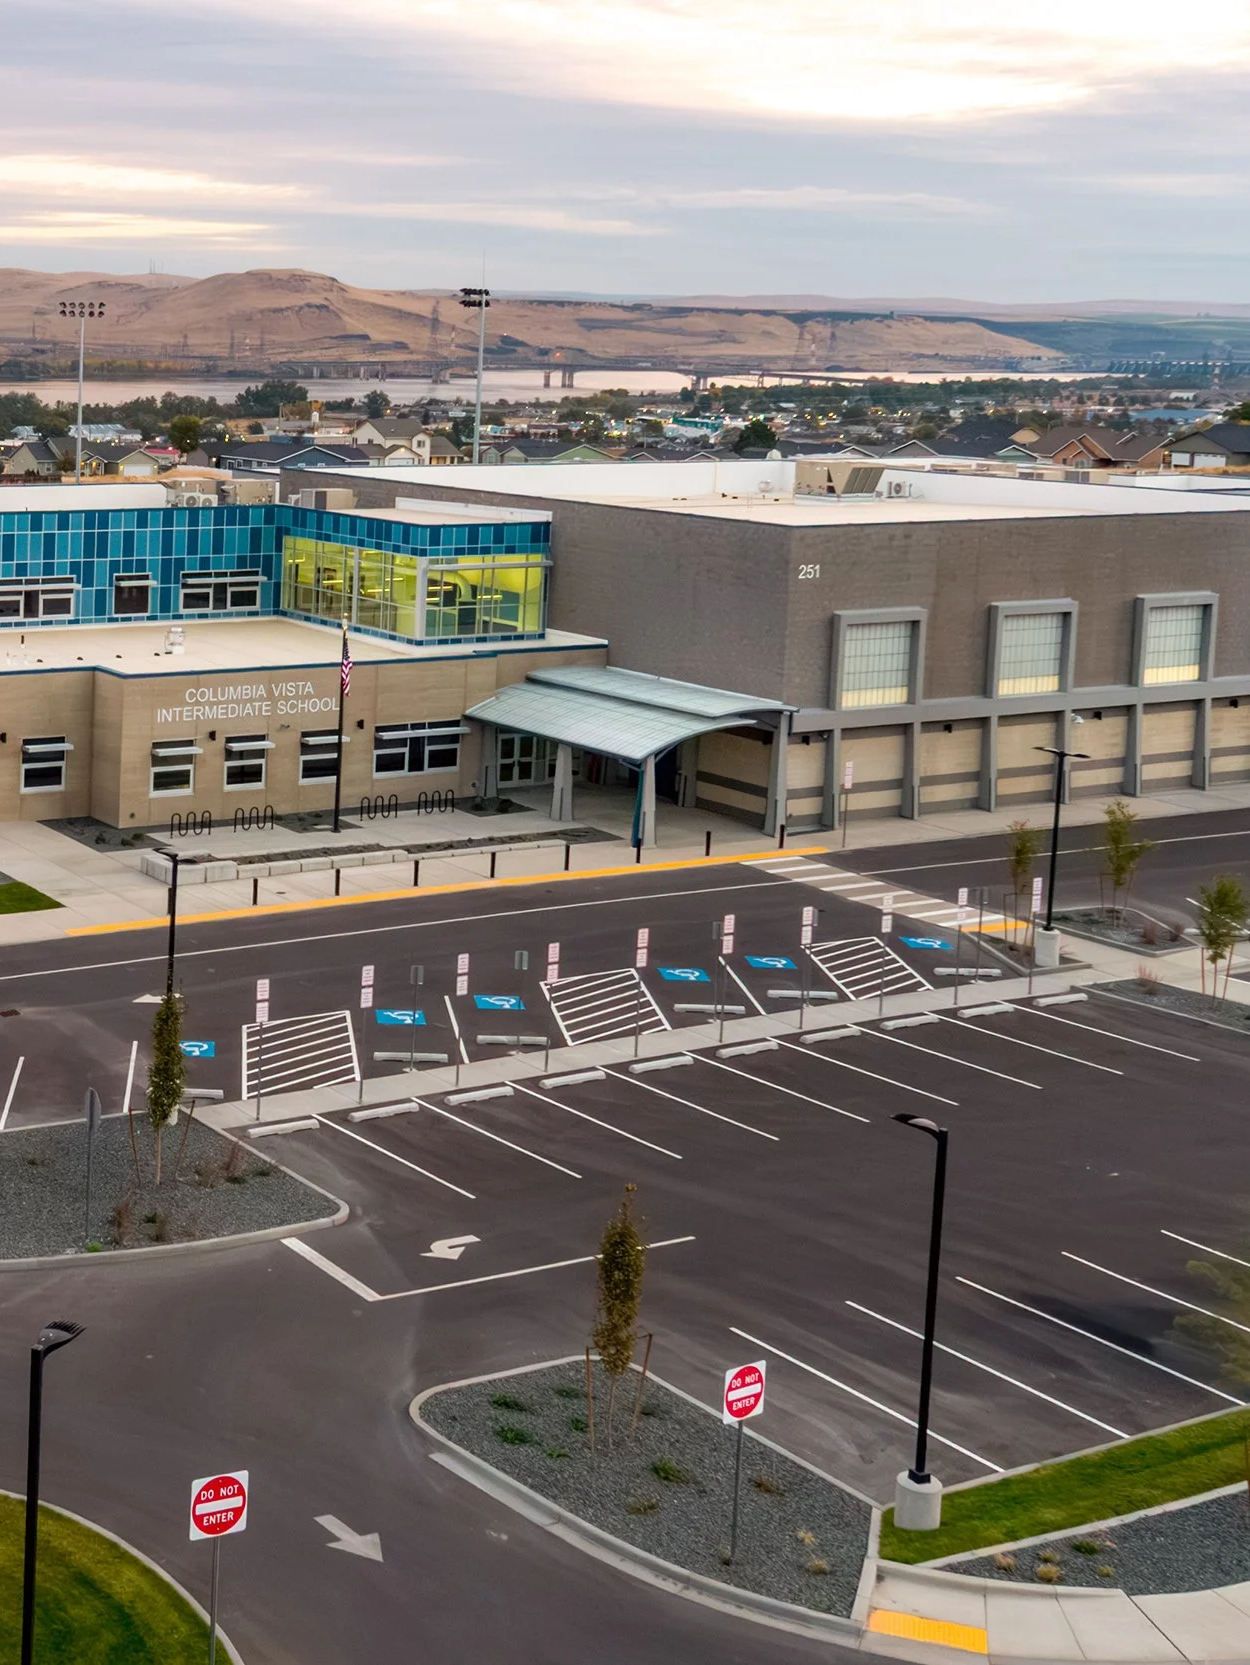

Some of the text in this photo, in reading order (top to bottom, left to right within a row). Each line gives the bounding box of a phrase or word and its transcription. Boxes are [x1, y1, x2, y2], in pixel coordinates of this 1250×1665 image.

[798, 564, 820, 579] 251
[186, 681, 314, 702] COLUMBIA VISTA
[157, 697, 340, 723] INTERMEDIATE SCHOOL
[731, 1372, 759, 1388] DO NOT
[732, 1397, 755, 1411] ENTER
[200, 1484, 239, 1501] DO NOT
[203, 1511, 234, 1526] ENTER
